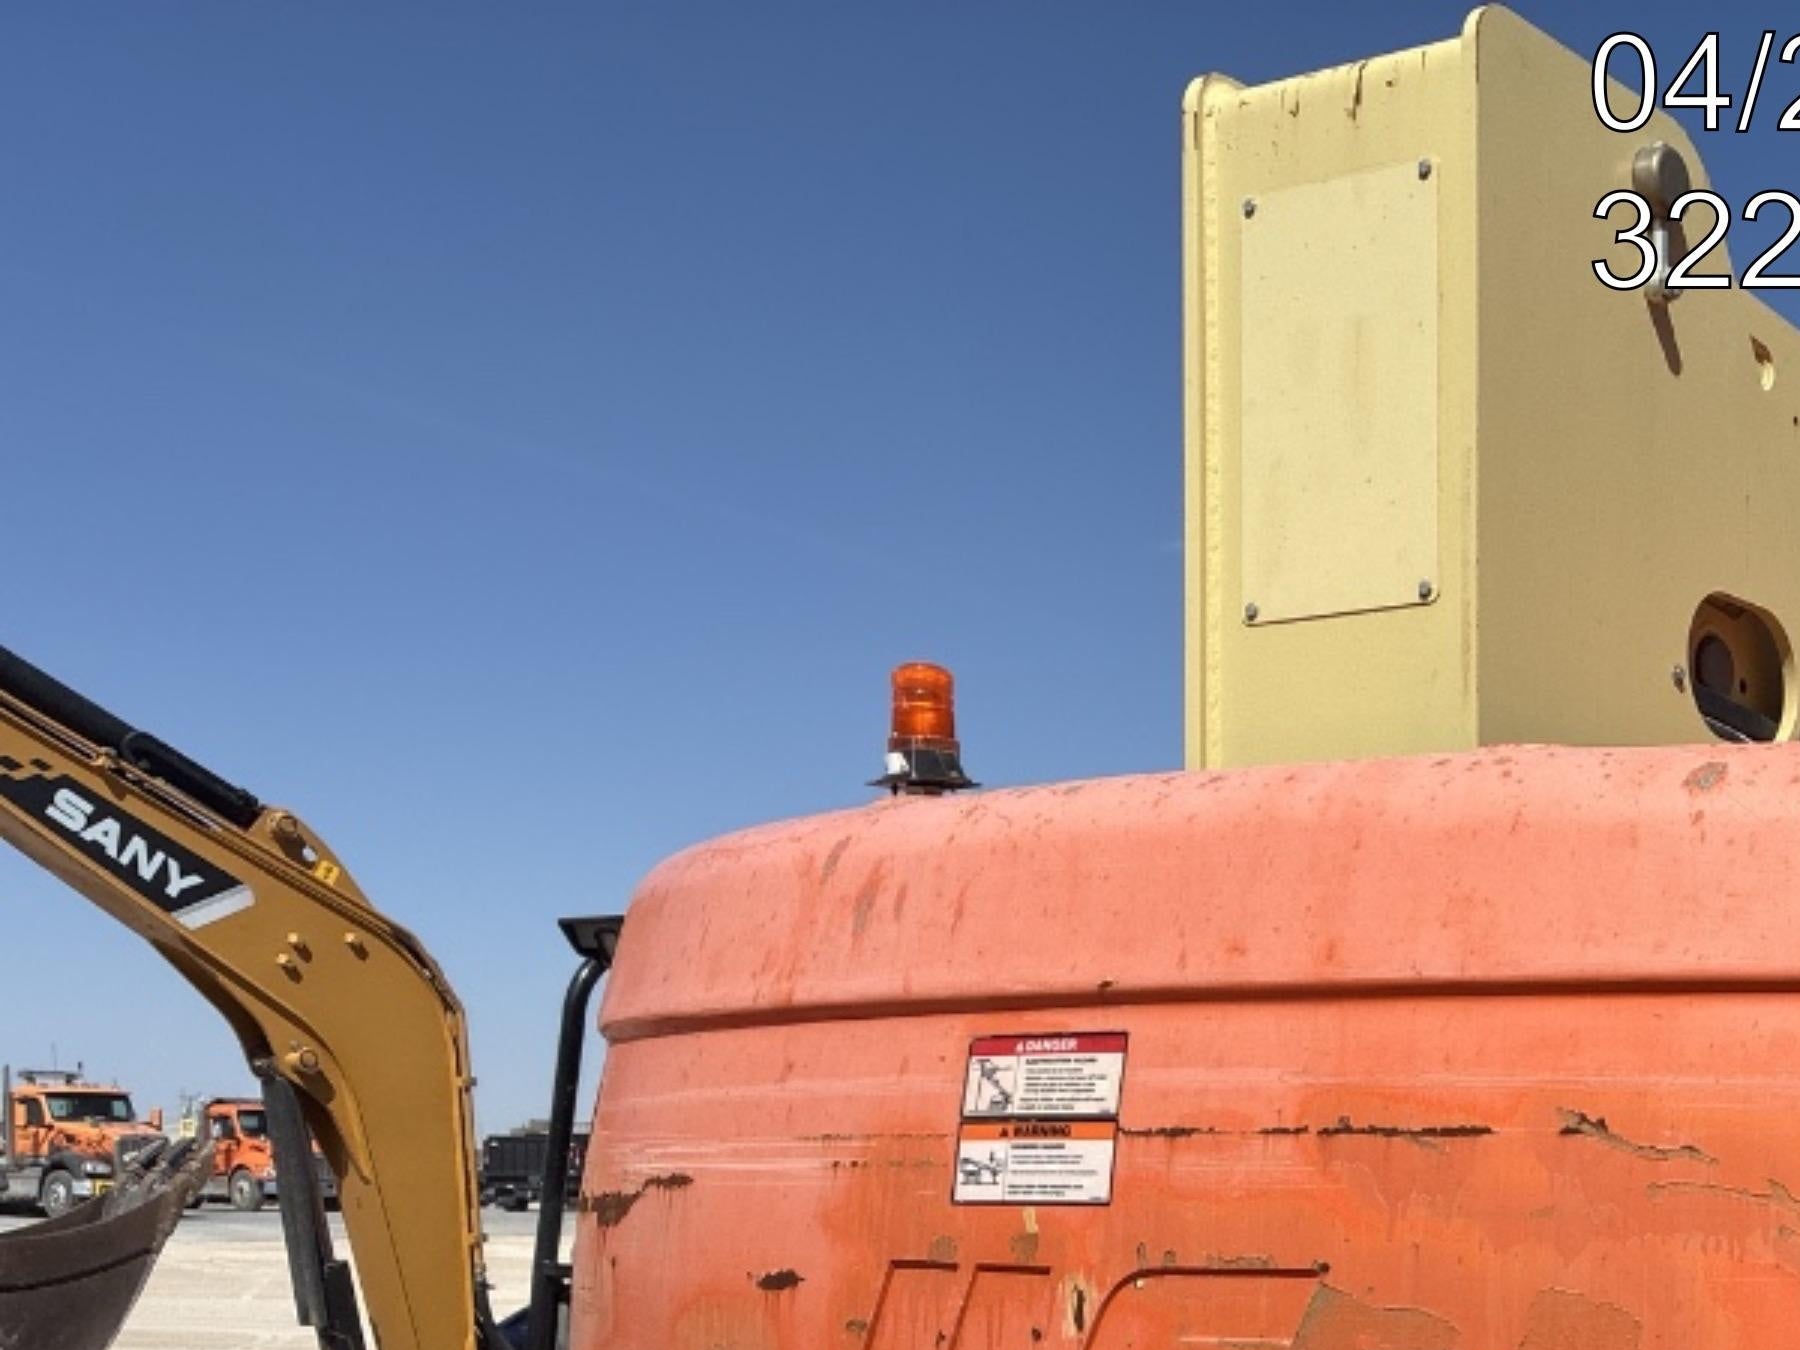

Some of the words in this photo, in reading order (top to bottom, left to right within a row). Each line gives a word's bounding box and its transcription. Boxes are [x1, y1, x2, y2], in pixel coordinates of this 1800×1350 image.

[46, 788, 204, 898] SANY
[1025, 1037, 1078, 1052] DANGER
[1013, 1123, 1072, 1138] WARNING
